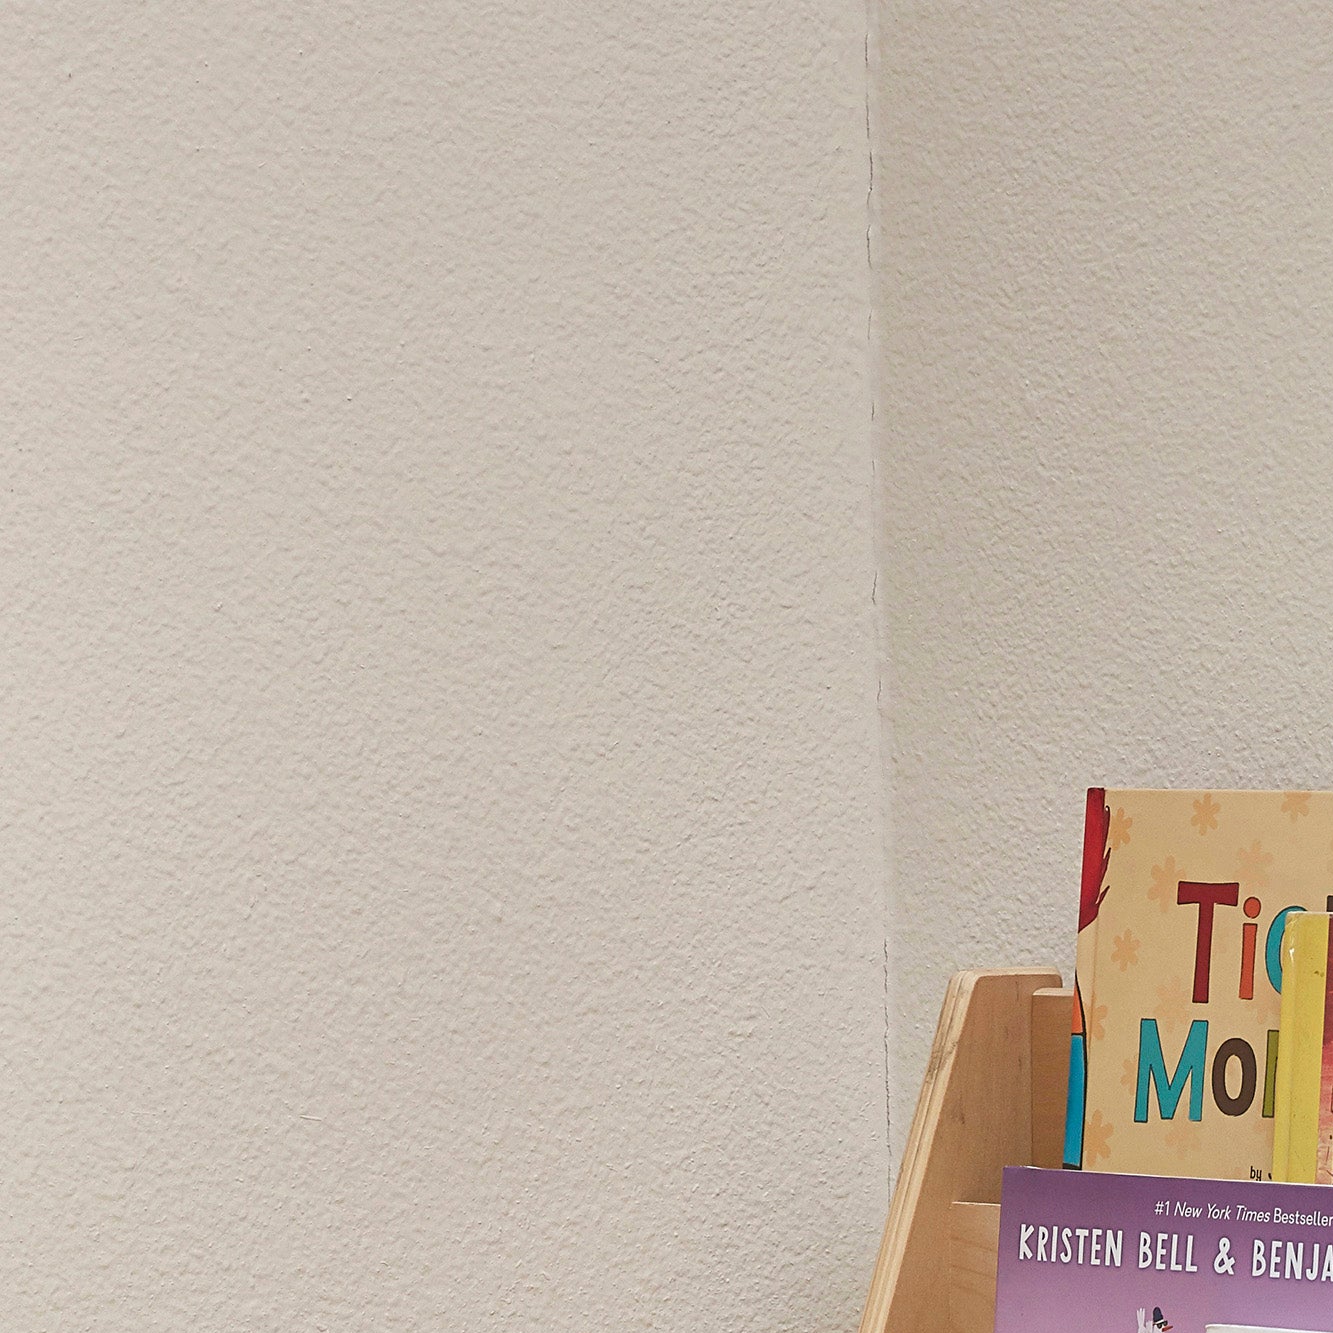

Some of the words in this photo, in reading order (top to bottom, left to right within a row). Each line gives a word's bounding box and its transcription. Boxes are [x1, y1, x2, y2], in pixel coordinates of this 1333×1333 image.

[1250, 1165, 1262, 1181] by
[1154, 1201, 1170, 1216] #1
[1174, 1201, 1202, 1218] New
[1207, 1203, 1231, 1220] York
[1235, 1205, 1270, 1223] Times
[1273, 1208, 1333, 1227] Bestseller
[1018, 1223, 1123, 1267] KRISTEN
[1137, 1233, 1198, 1273] BELL
[1213, 1240, 1236, 1276] &
